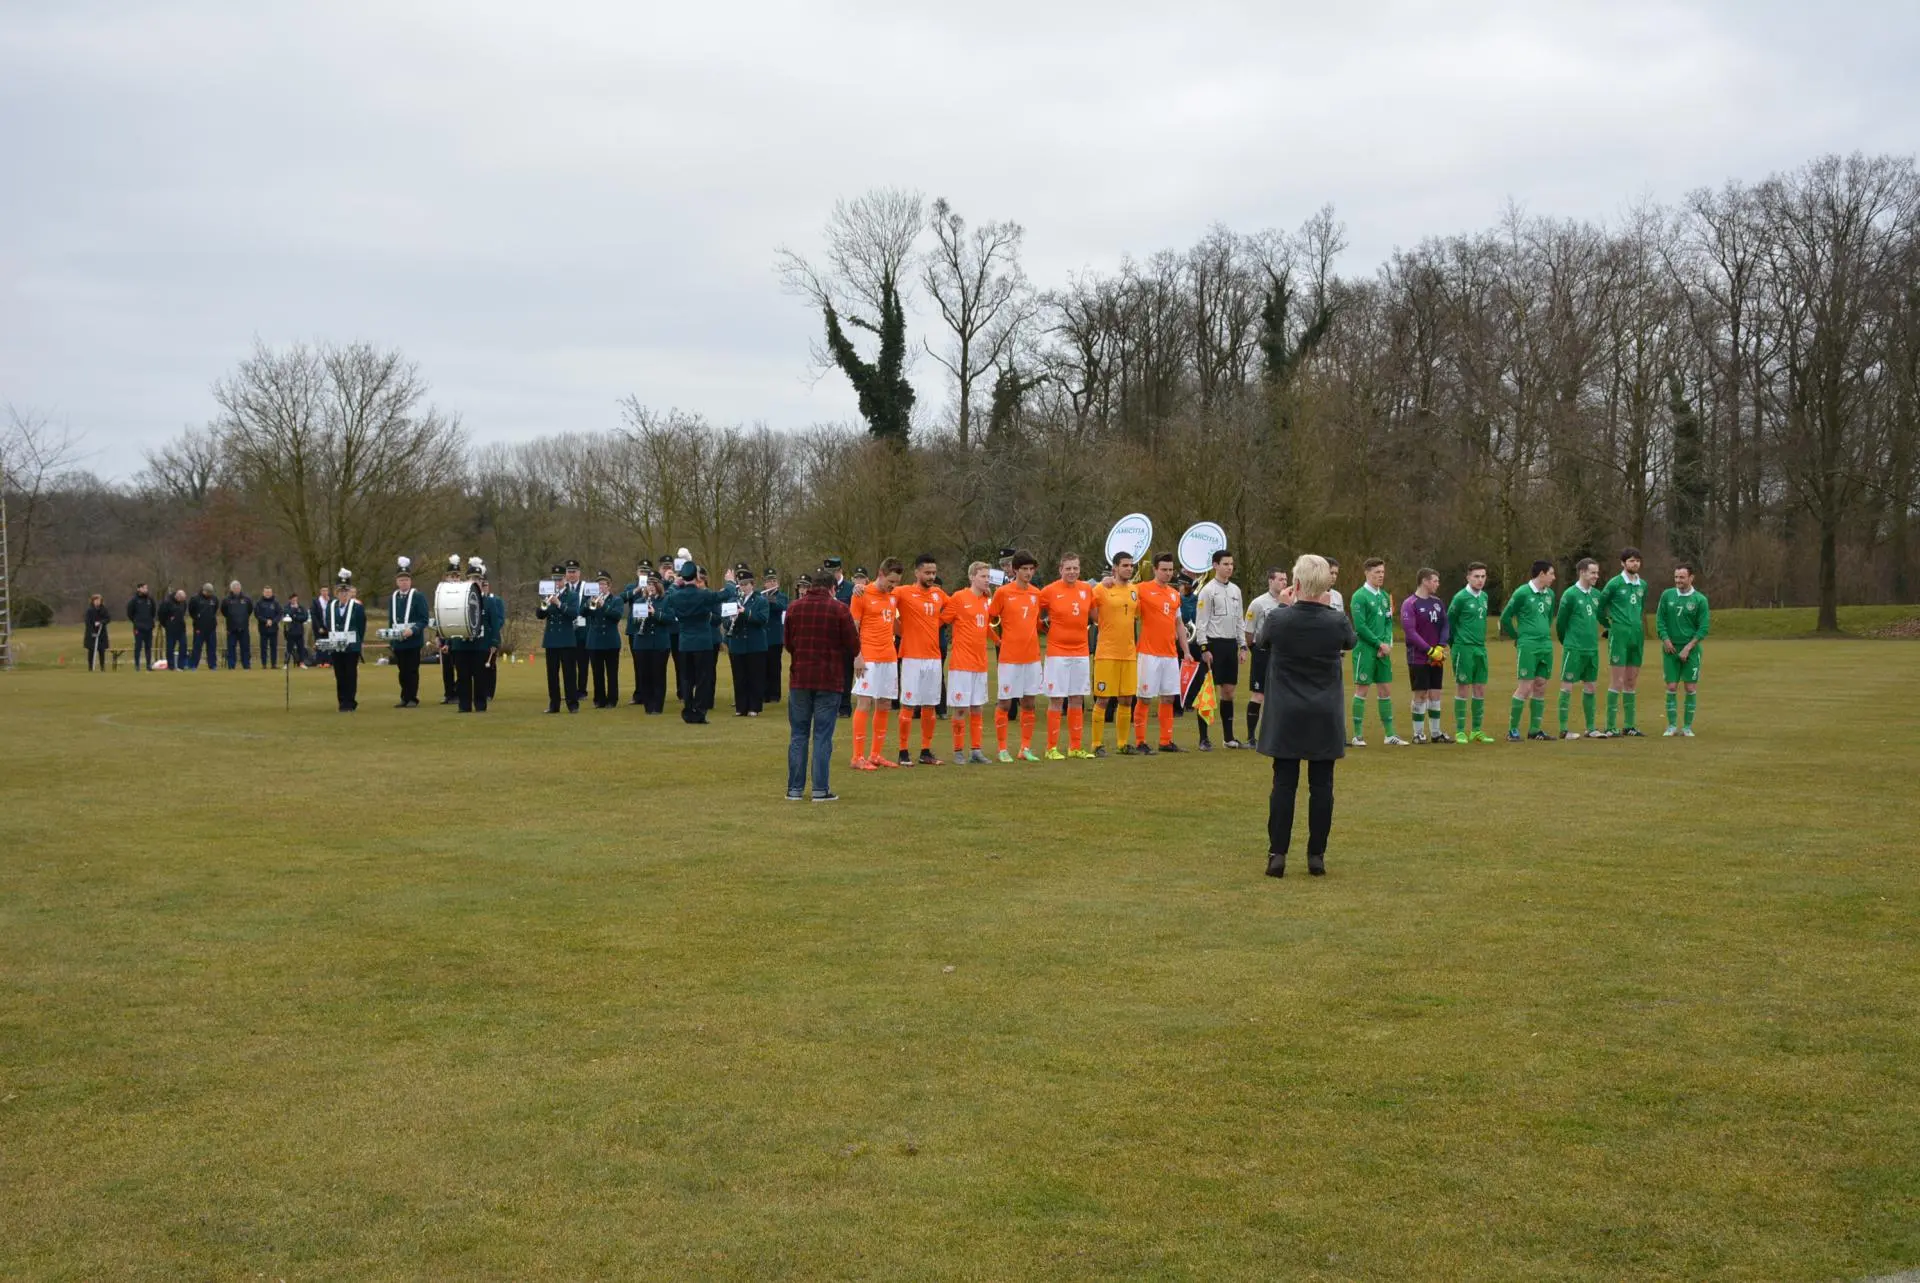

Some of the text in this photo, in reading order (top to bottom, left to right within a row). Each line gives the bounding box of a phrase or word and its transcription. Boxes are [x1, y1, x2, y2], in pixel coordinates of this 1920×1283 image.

[1630, 594, 1637, 605] 8
[924, 602, 934, 616] 11
[1021, 606, 1029, 618] 7
[1072, 602, 1080, 616] 3
[1163, 602, 1170, 615] 8
[1478, 607, 1484, 619] 2
[1538, 602, 1545, 613] 3
[1677, 606, 1683, 616] 7
[975, 613, 984, 628] 10
[1429, 610, 1438, 623] 14
